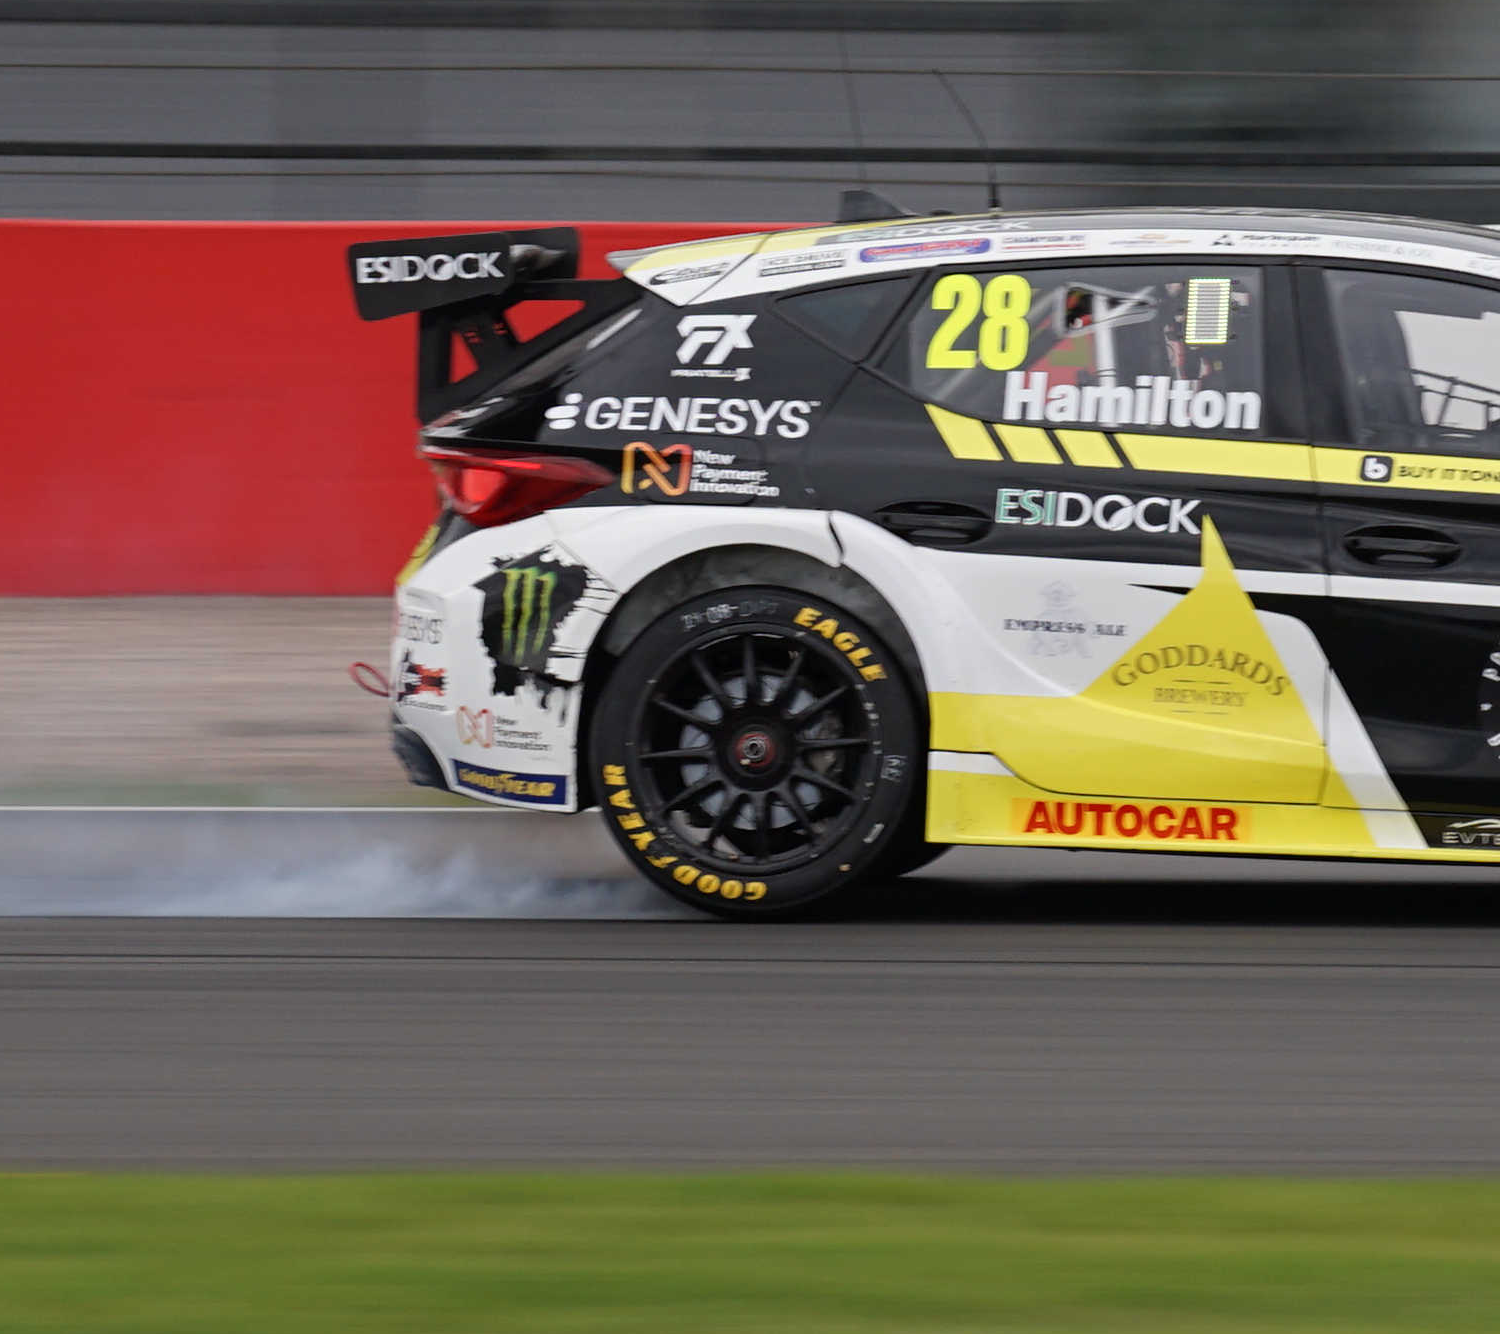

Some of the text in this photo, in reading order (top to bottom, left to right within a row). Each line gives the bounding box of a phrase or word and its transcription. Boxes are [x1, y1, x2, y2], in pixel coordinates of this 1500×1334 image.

[355, 249, 506, 285] ESIDOCK
[926, 273, 1031, 371] 28
[584, 396, 811, 439] GENESYS
[1002, 370, 1261, 430] Hamilton
[693, 449, 736, 465] New
[1399, 465, 1435, 478] BUY
[994, 487, 1203, 536] ESIDOCK
[793, 606, 888, 682] EAGLE
[1111, 643, 1291, 698] GODDARDS
[1153, 687, 1249, 708] BREWERY
[1024, 800, 1240, 841] AUTOCAR
